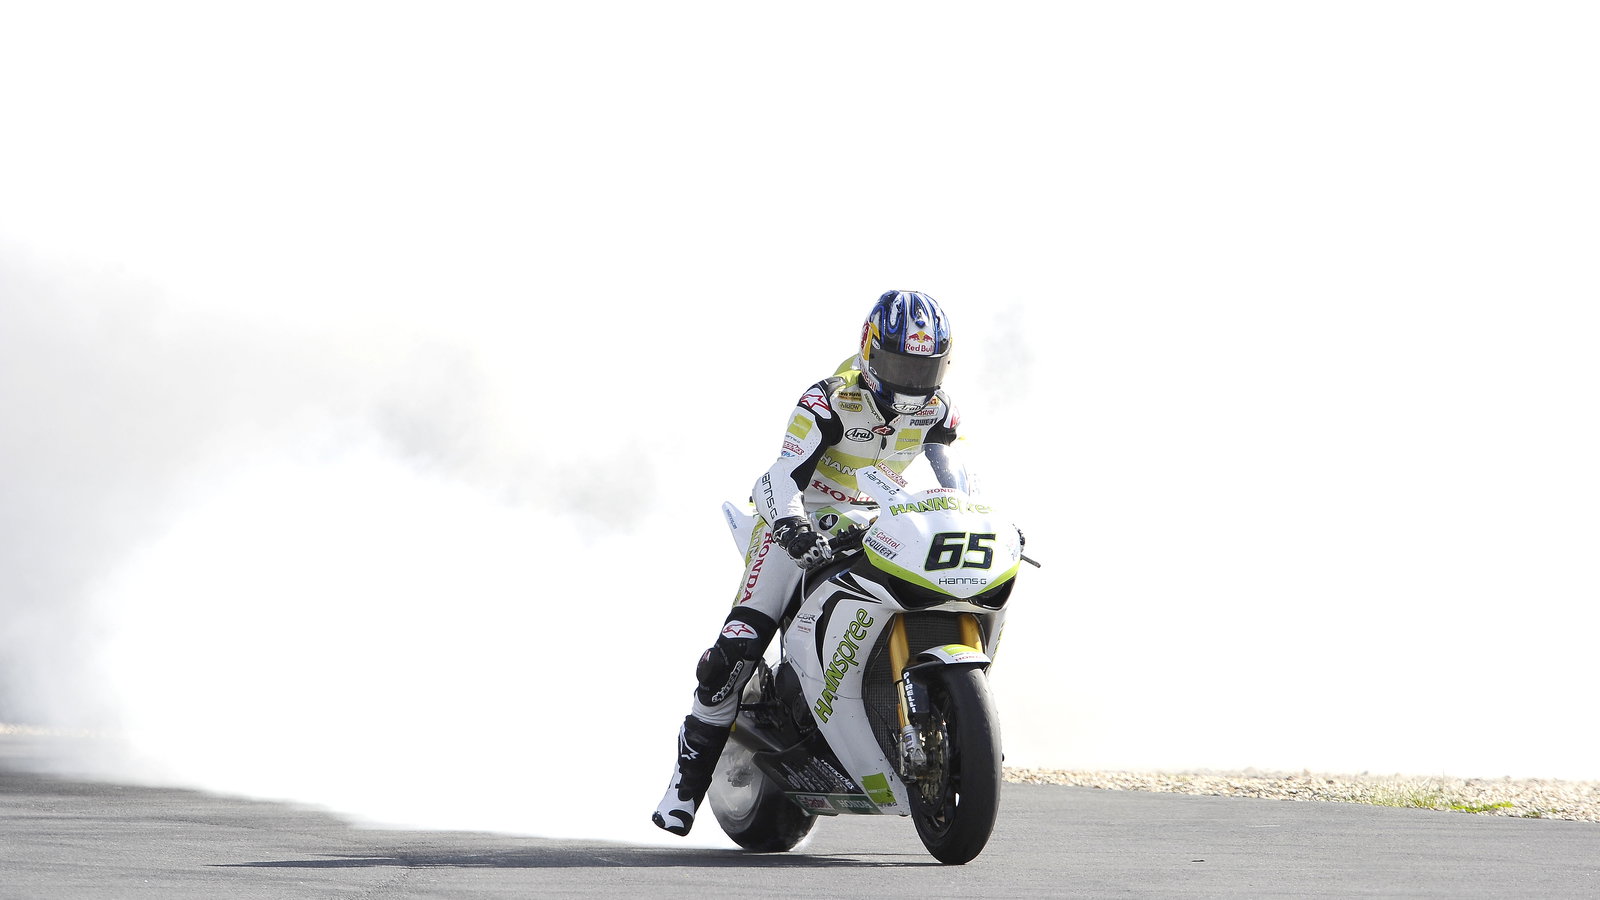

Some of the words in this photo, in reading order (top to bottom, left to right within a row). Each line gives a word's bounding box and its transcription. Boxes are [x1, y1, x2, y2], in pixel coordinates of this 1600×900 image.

[906, 343, 920, 352] Red
[848, 429, 871, 440] Arai
[876, 531, 900, 550] Castrol
[924, 532, 996, 572] 65
[740, 531, 773, 605] HONDA
[836, 799, 873, 809] HONDA
